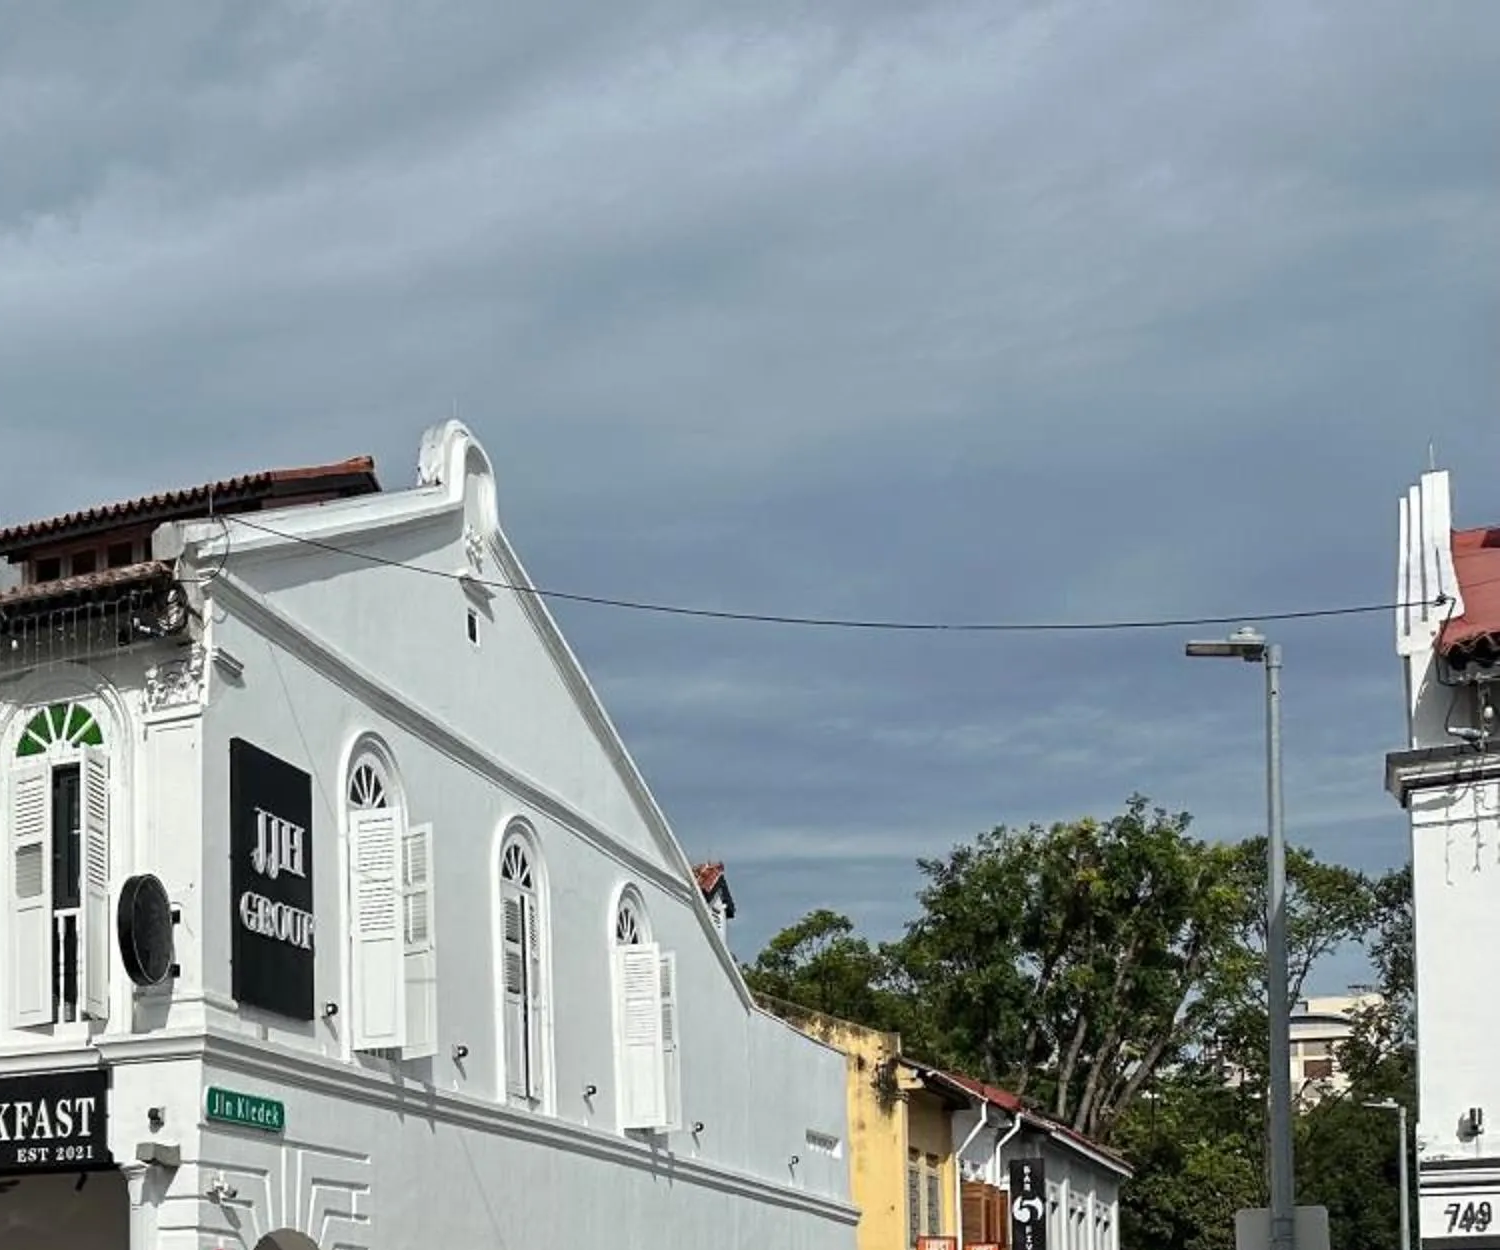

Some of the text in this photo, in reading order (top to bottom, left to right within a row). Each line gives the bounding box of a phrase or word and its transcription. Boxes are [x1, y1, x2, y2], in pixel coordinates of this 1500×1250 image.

[251, 807, 306, 880] JJH
[240, 891, 315, 950] GROUP
[213, 1092, 233, 1116] Jln
[17, 1146, 94, 1163] EST 2021
[1445, 1201, 1492, 1232] 749
